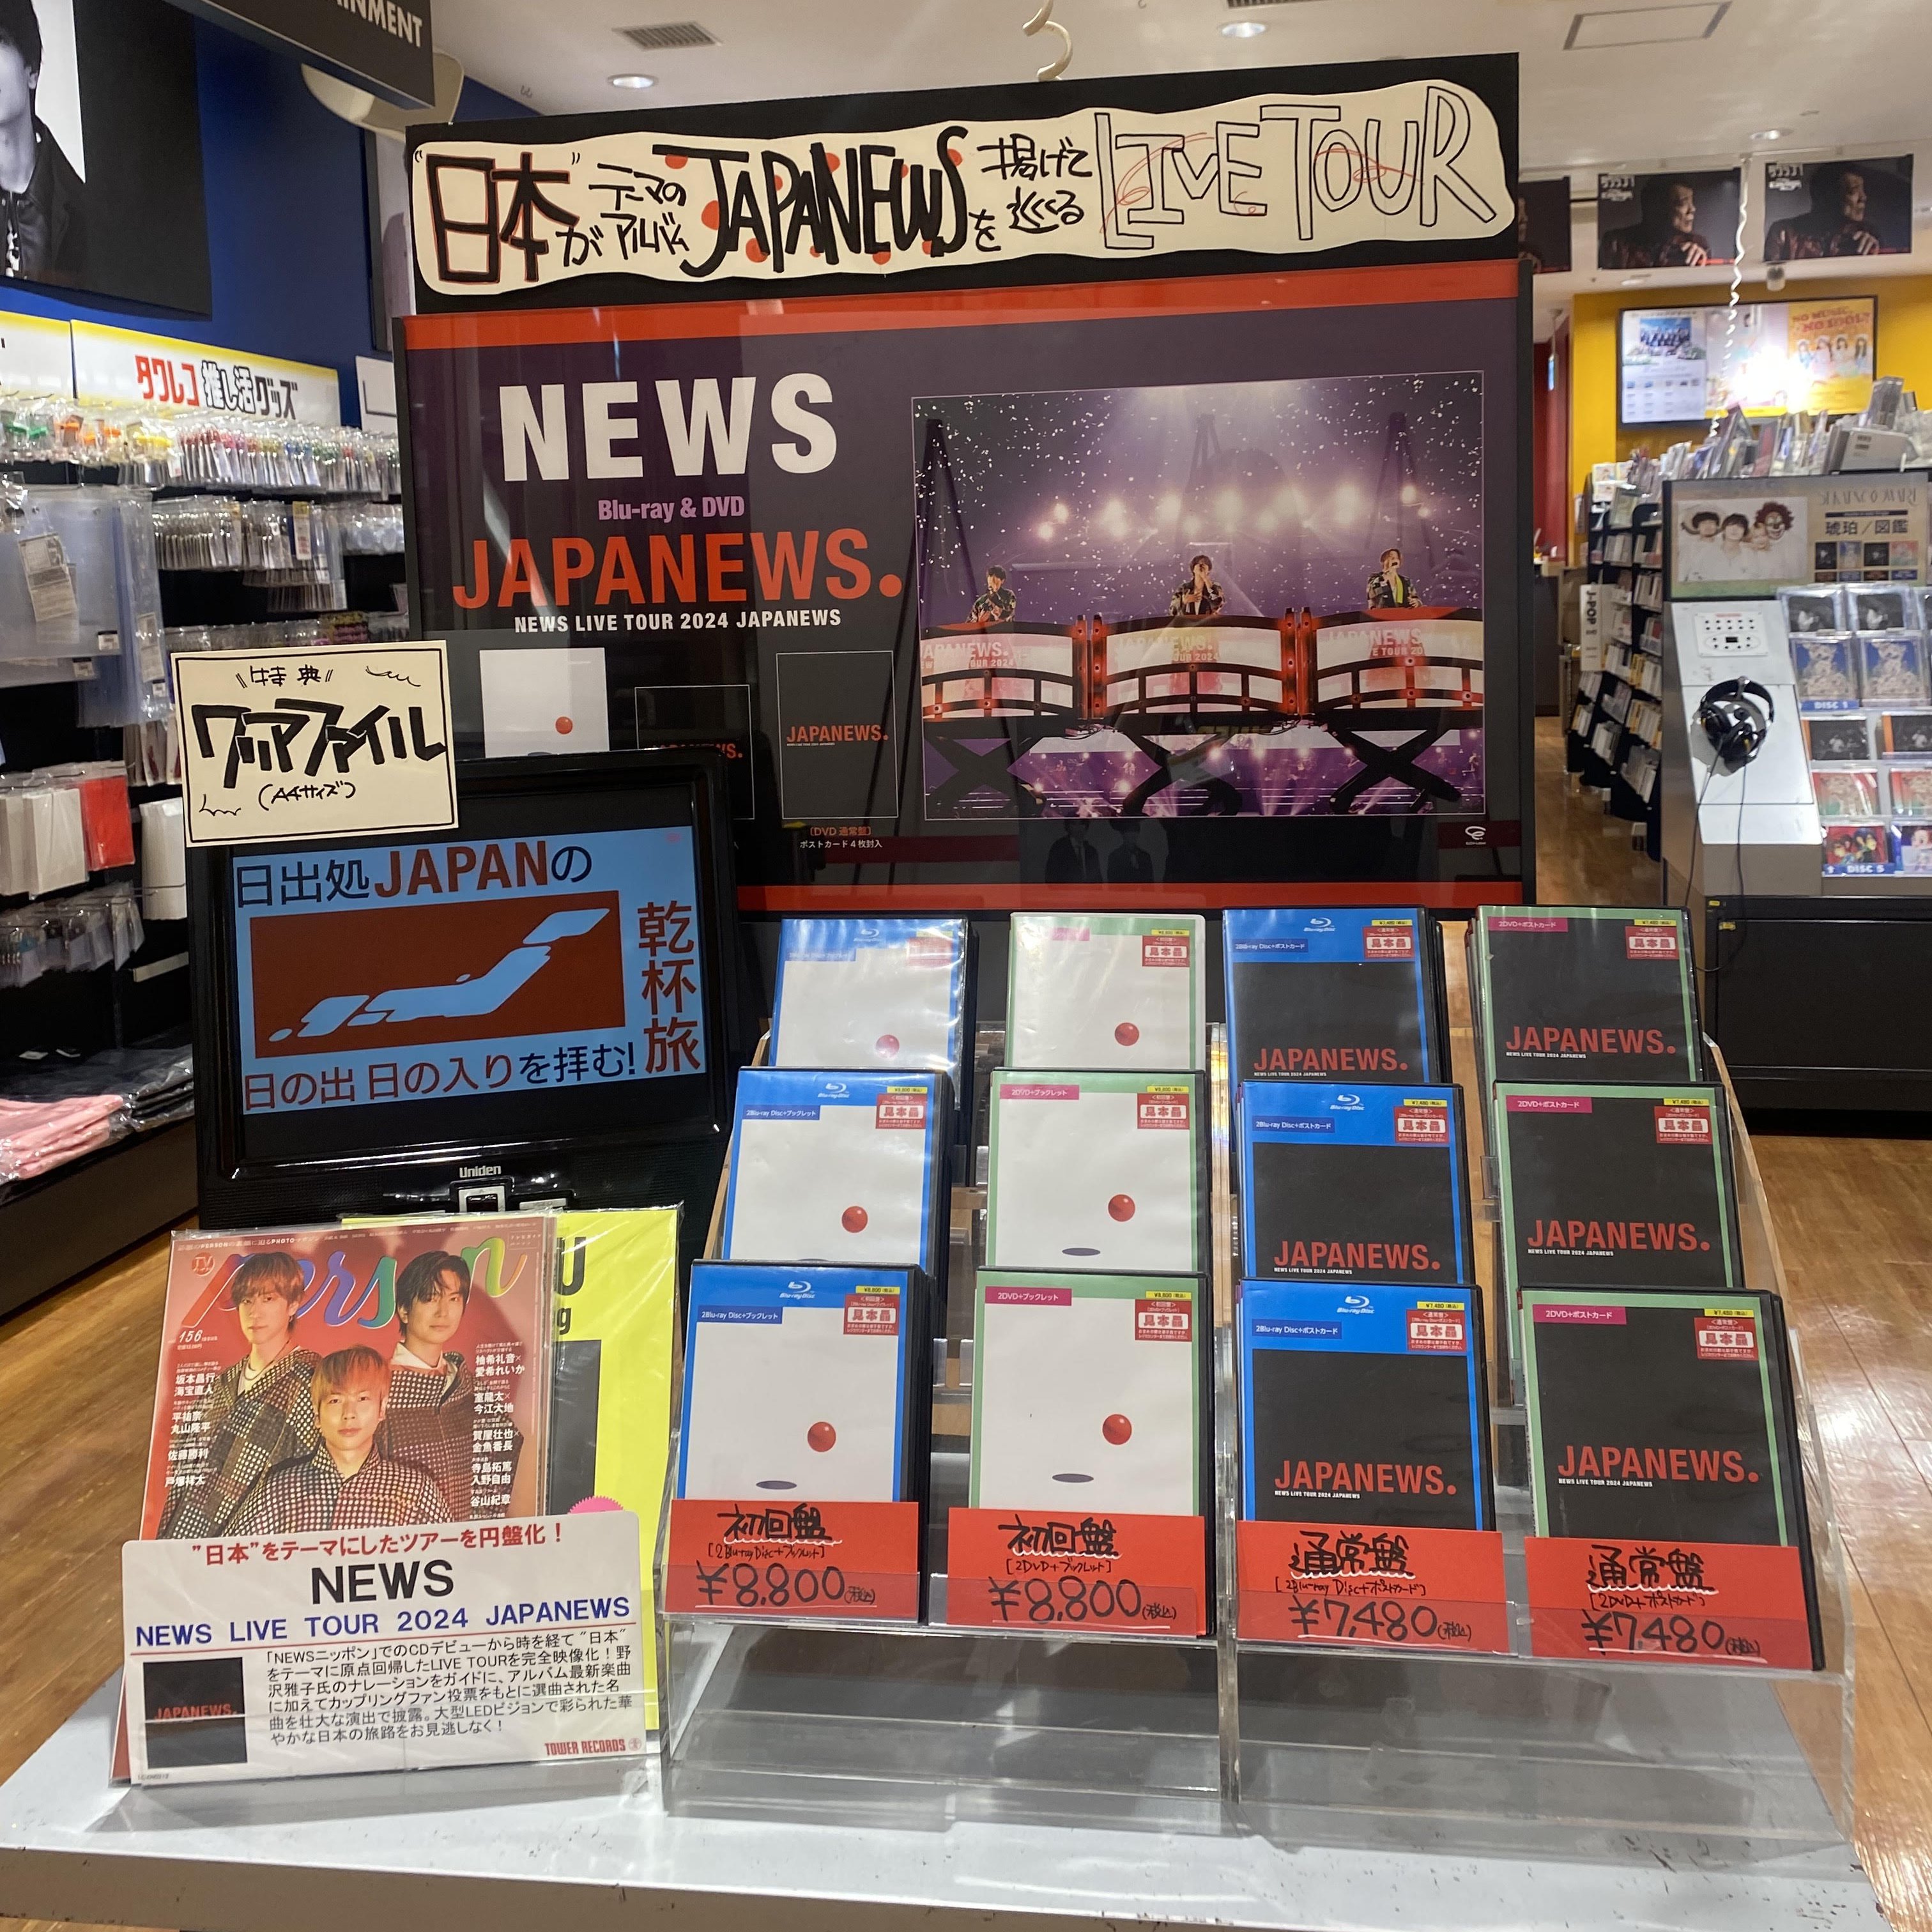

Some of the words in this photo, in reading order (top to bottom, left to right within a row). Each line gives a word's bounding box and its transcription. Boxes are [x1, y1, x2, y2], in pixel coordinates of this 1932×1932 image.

[1094, 112, 1268, 249] LIVE
[1260, 86, 1496, 240] TOUR
[652, 126, 969, 277] JAPANEWS
[600, 211, 690, 260] アルバム
[500, 372, 837, 482] NEWS
[598, 499, 674, 523] Blu-ray
[680, 498, 696, 518] &
[703, 496, 745, 518] DVD
[452, 528, 903, 609] JAPANEWS.
[514, 615, 569, 632] NEWS
[575, 614, 618, 631] LIVE
[624, 613, 674, 630] TOUR
[680, 611, 729, 629] 2024
[736, 609, 842, 628] JAPANEWS
[1813, 701, 1838, 709] DISC
[786, 724, 889, 742] JAPANEWS.
[236, 840, 592, 908] 日出処JAPANの
[1846, 865, 1873, 873] DISC
[1876, 865, 1885, 873] 5
[638, 900, 701, 1075] 乾杯旅
[1506, 1025, 1676, 1055] JAPANEWS.
[1254, 1048, 1409, 1071] JAPANEWS.
[245, 1066, 356, 1112] 日の出
[884, 1106, 919, 1117] 見本品
[1144, 1106, 1182, 1117] 見本品
[1402, 1120, 1441, 1131] 見本品
[1664, 1119, 1704, 1132] 見本品
[459, 1163, 502, 1179] Uniden
[1528, 1220, 1711, 1251] JAPANEWS.
[1274, 1241, 1441, 1270] JAPANEWS.
[997, 1292, 1059, 1301] 2DVD+ブックレット
[701, 1312, 727, 1320] 2Blu-ray
[852, 1308, 891, 1321] 見本品
[1143, 1314, 1183, 1328] 見本品
[1545, 1310, 1613, 1319] 2DVD+ポストカード
[178, 1330, 204, 1344] 156
[1255, 1325, 1283, 1334] 2Blu-ray
[1284, 1326, 1338, 1335] Disc+ポストカード
[1416, 1325, 1457, 1338] 見本品
[1705, 1332, 1749, 1346] 見本品
[1558, 1445, 1759, 1483] JAPANEWS.
[1275, 1460, 1457, 1495] JAPANEWS.
[717, 1502, 833, 1540] 初回盤
[997, 1514, 1120, 1556] 初回盤
[1287, 1530, 1414, 1576] 通常盤
[1585, 1544, 1715, 1592] 通常盤
[310, 1560, 455, 1605] NEWS
[136, 1623, 212, 1646] NEWS
[229, 1619, 288, 1641] LIVE
[305, 1614, 379, 1638] TOUR
[397, 1609, 468, 1632] 2024
[486, 1597, 630, 1626] JAPANEWS
[544, 1740, 579, 1756] TOWER
[582, 1738, 626, 1753] RECORDS
